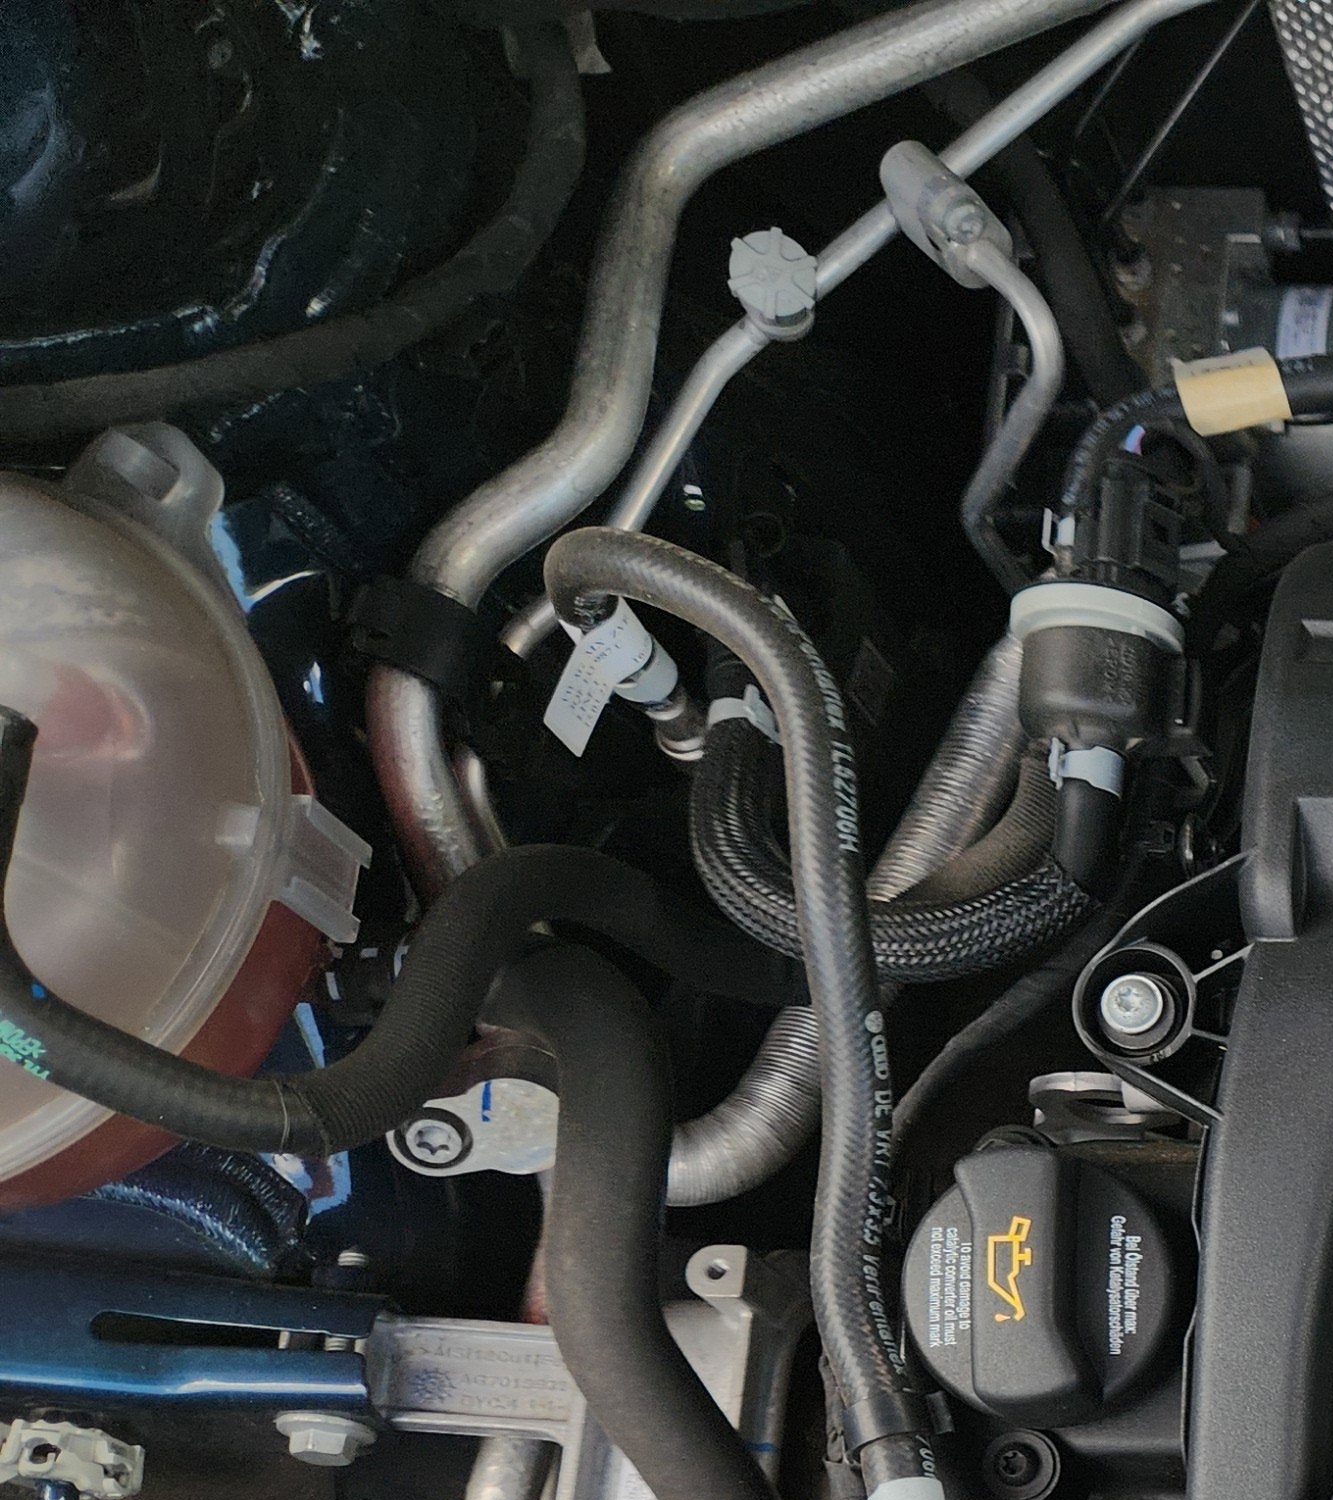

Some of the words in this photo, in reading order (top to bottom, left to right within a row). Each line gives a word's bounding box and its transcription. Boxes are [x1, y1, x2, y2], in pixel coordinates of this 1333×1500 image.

[930, 1227, 943, 1242] not
[1110, 1215, 1126, 1246] Gefahr
[1125, 1235, 1142, 1251] Bei
[943, 1227, 959, 1264] catalytic
[1109, 1248, 1122, 1264] von
[930, 1243, 942, 1275] exceed
[960, 1255, 972, 1279] avoid
[1125, 1253, 1143, 1287] Ölstand
[945, 1266, 957, 1307] converter
[929, 1277, 942, 1322] maximum
[956, 1281, 972, 1318] damage
[1106, 1266, 1124, 1355] Katalysatorschäden
[1125, 1289, 1140, 1310] über
[944, 1310, 957, 1320] oil
[960, 1320, 972, 1329] to
[929, 1324, 943, 1349] mark
[944, 1322, 957, 1345] must
